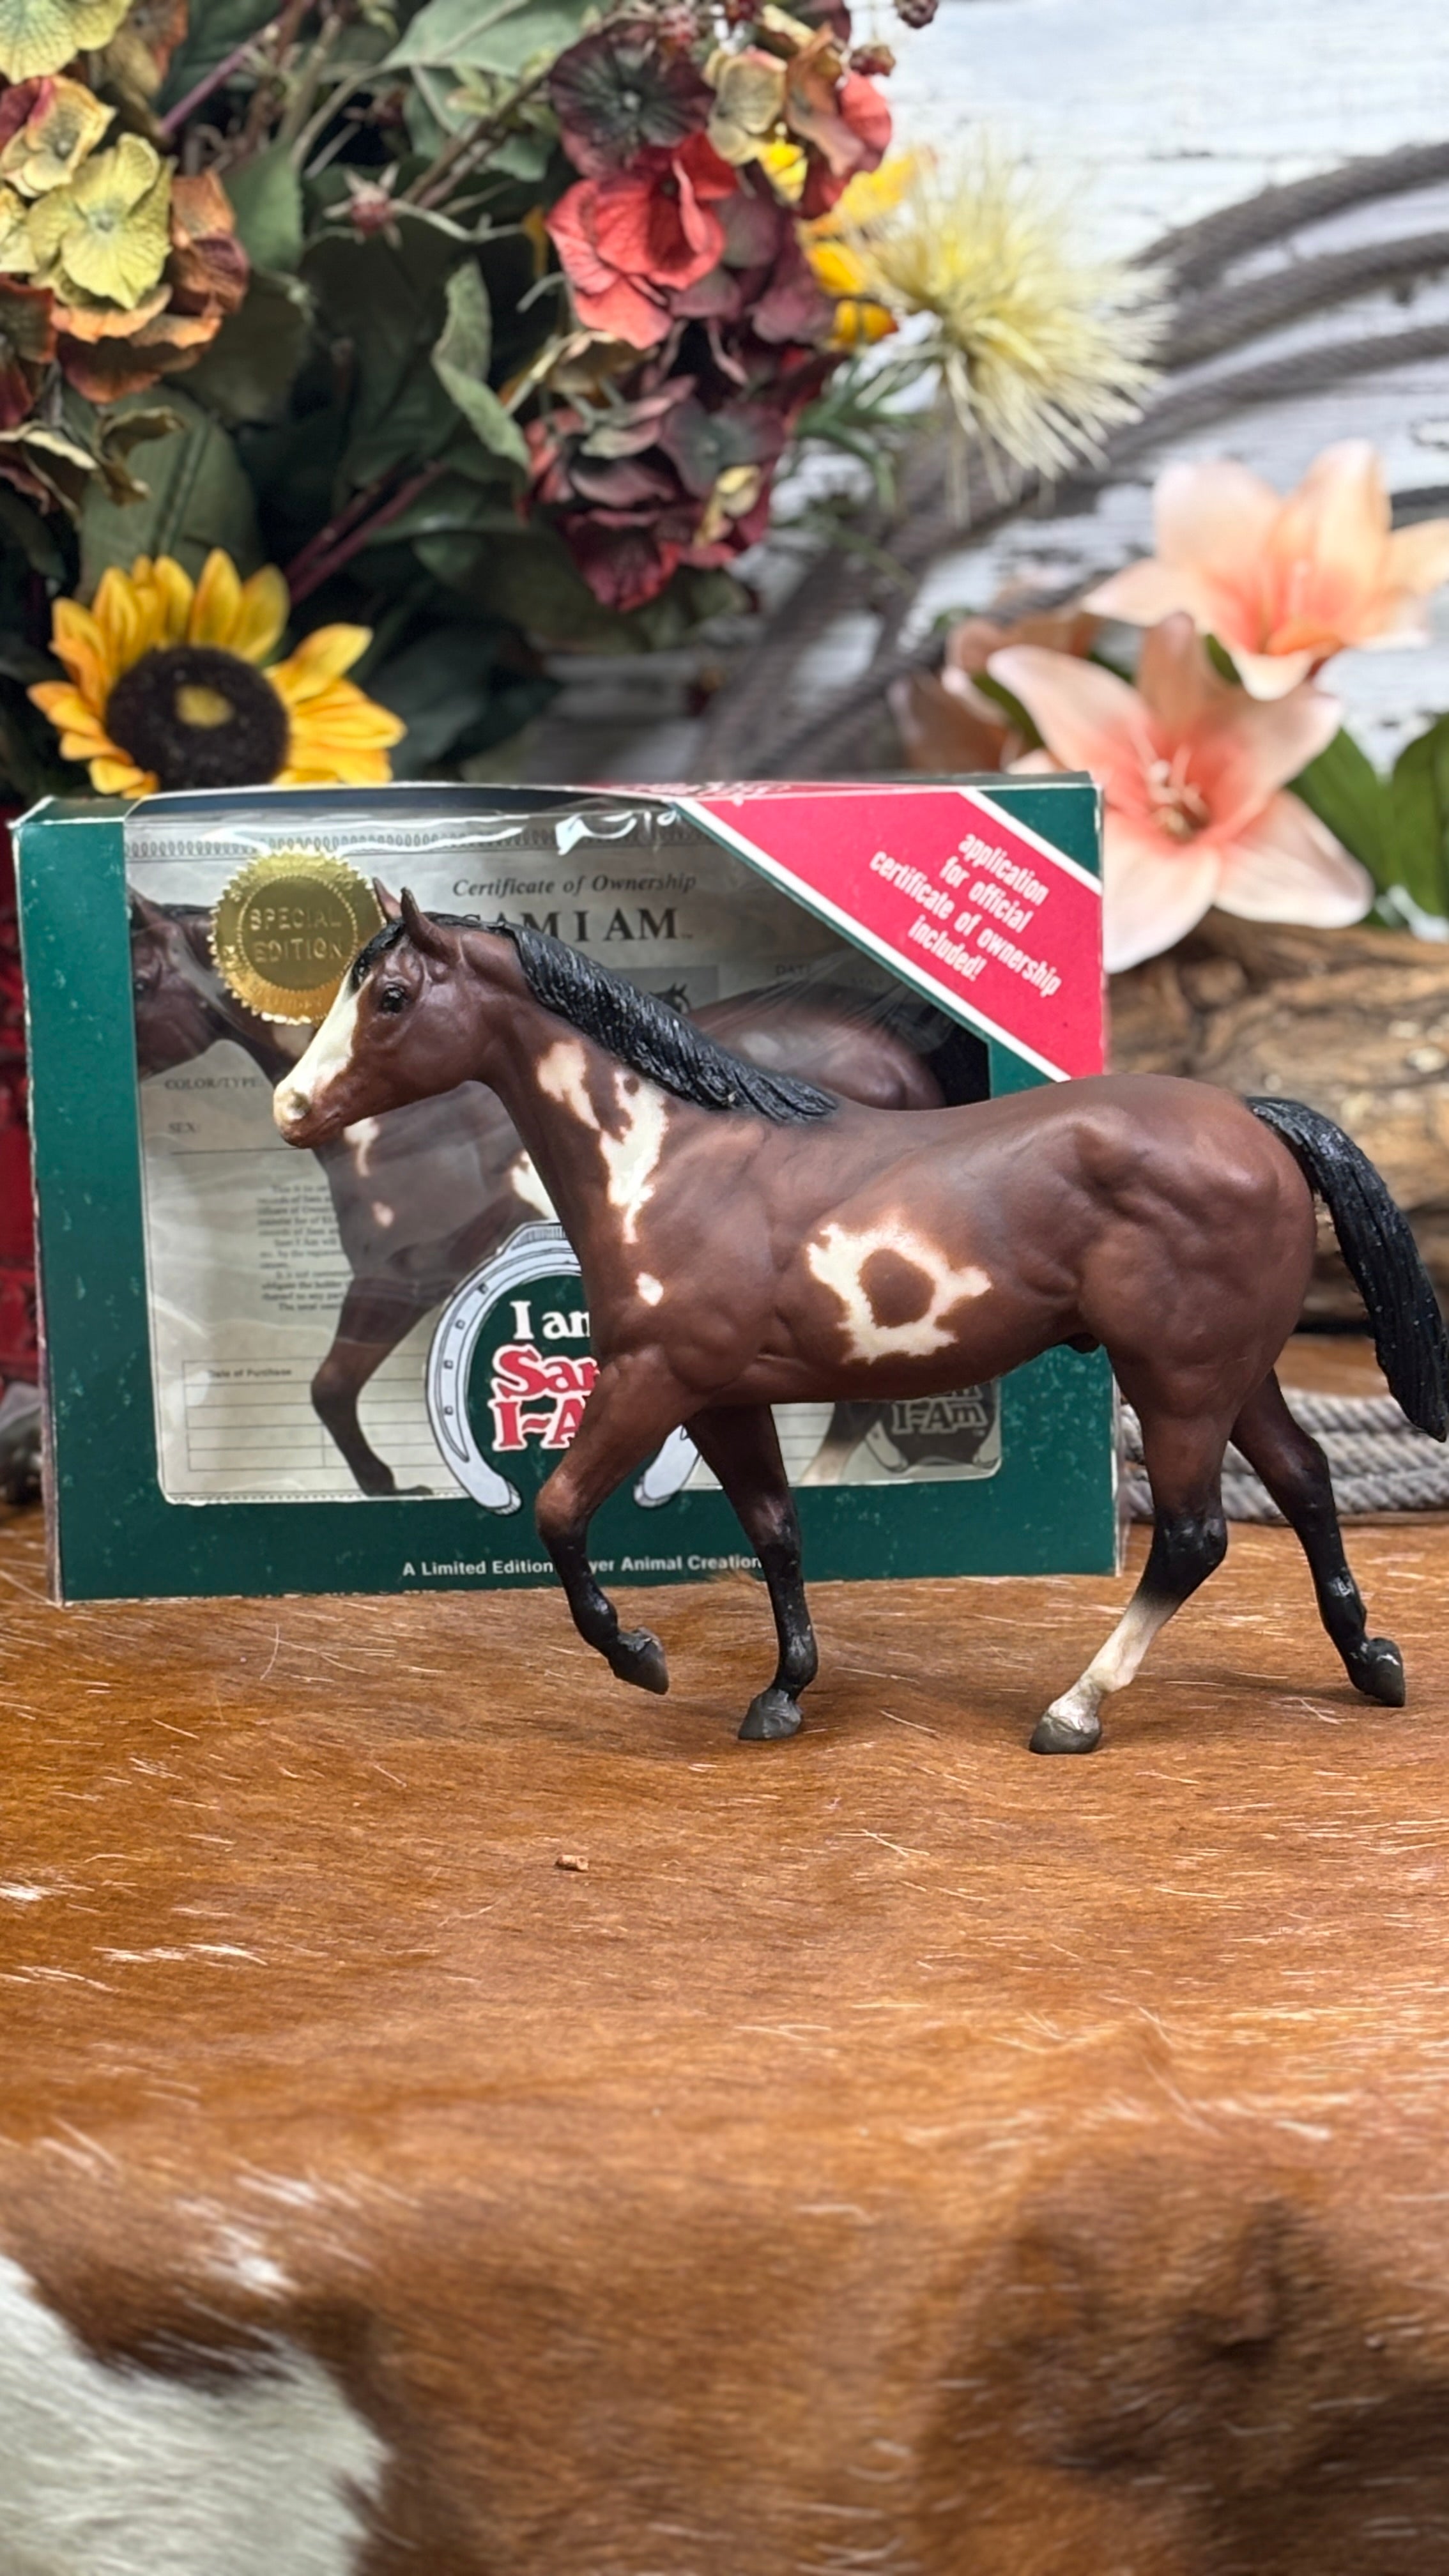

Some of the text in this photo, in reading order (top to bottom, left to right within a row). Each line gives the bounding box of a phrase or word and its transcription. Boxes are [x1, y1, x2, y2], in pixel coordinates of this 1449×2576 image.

[453, 872, 697, 898] Certificate of Ownership
[958, 833, 1050, 907] application
[939, 855, 1034, 933] for official
[250, 907, 342, 931] SPECIAL
[574, 910, 590, 941] I
[870, 851, 1062, 998] certificate of ownership
[254, 937, 343, 962] EDITION
[907, 914, 988, 982] included!
[510, 1300, 535, 1340] I
[487, 1394, 586, 1451] I-A
[402, 1562, 415, 1576] A
[422, 1560, 486, 1576] Limited
[492, 1559, 553, 1574] Edition
[621, 1556, 682, 1571] Animal
[687, 1554, 762, 1570] Creation
